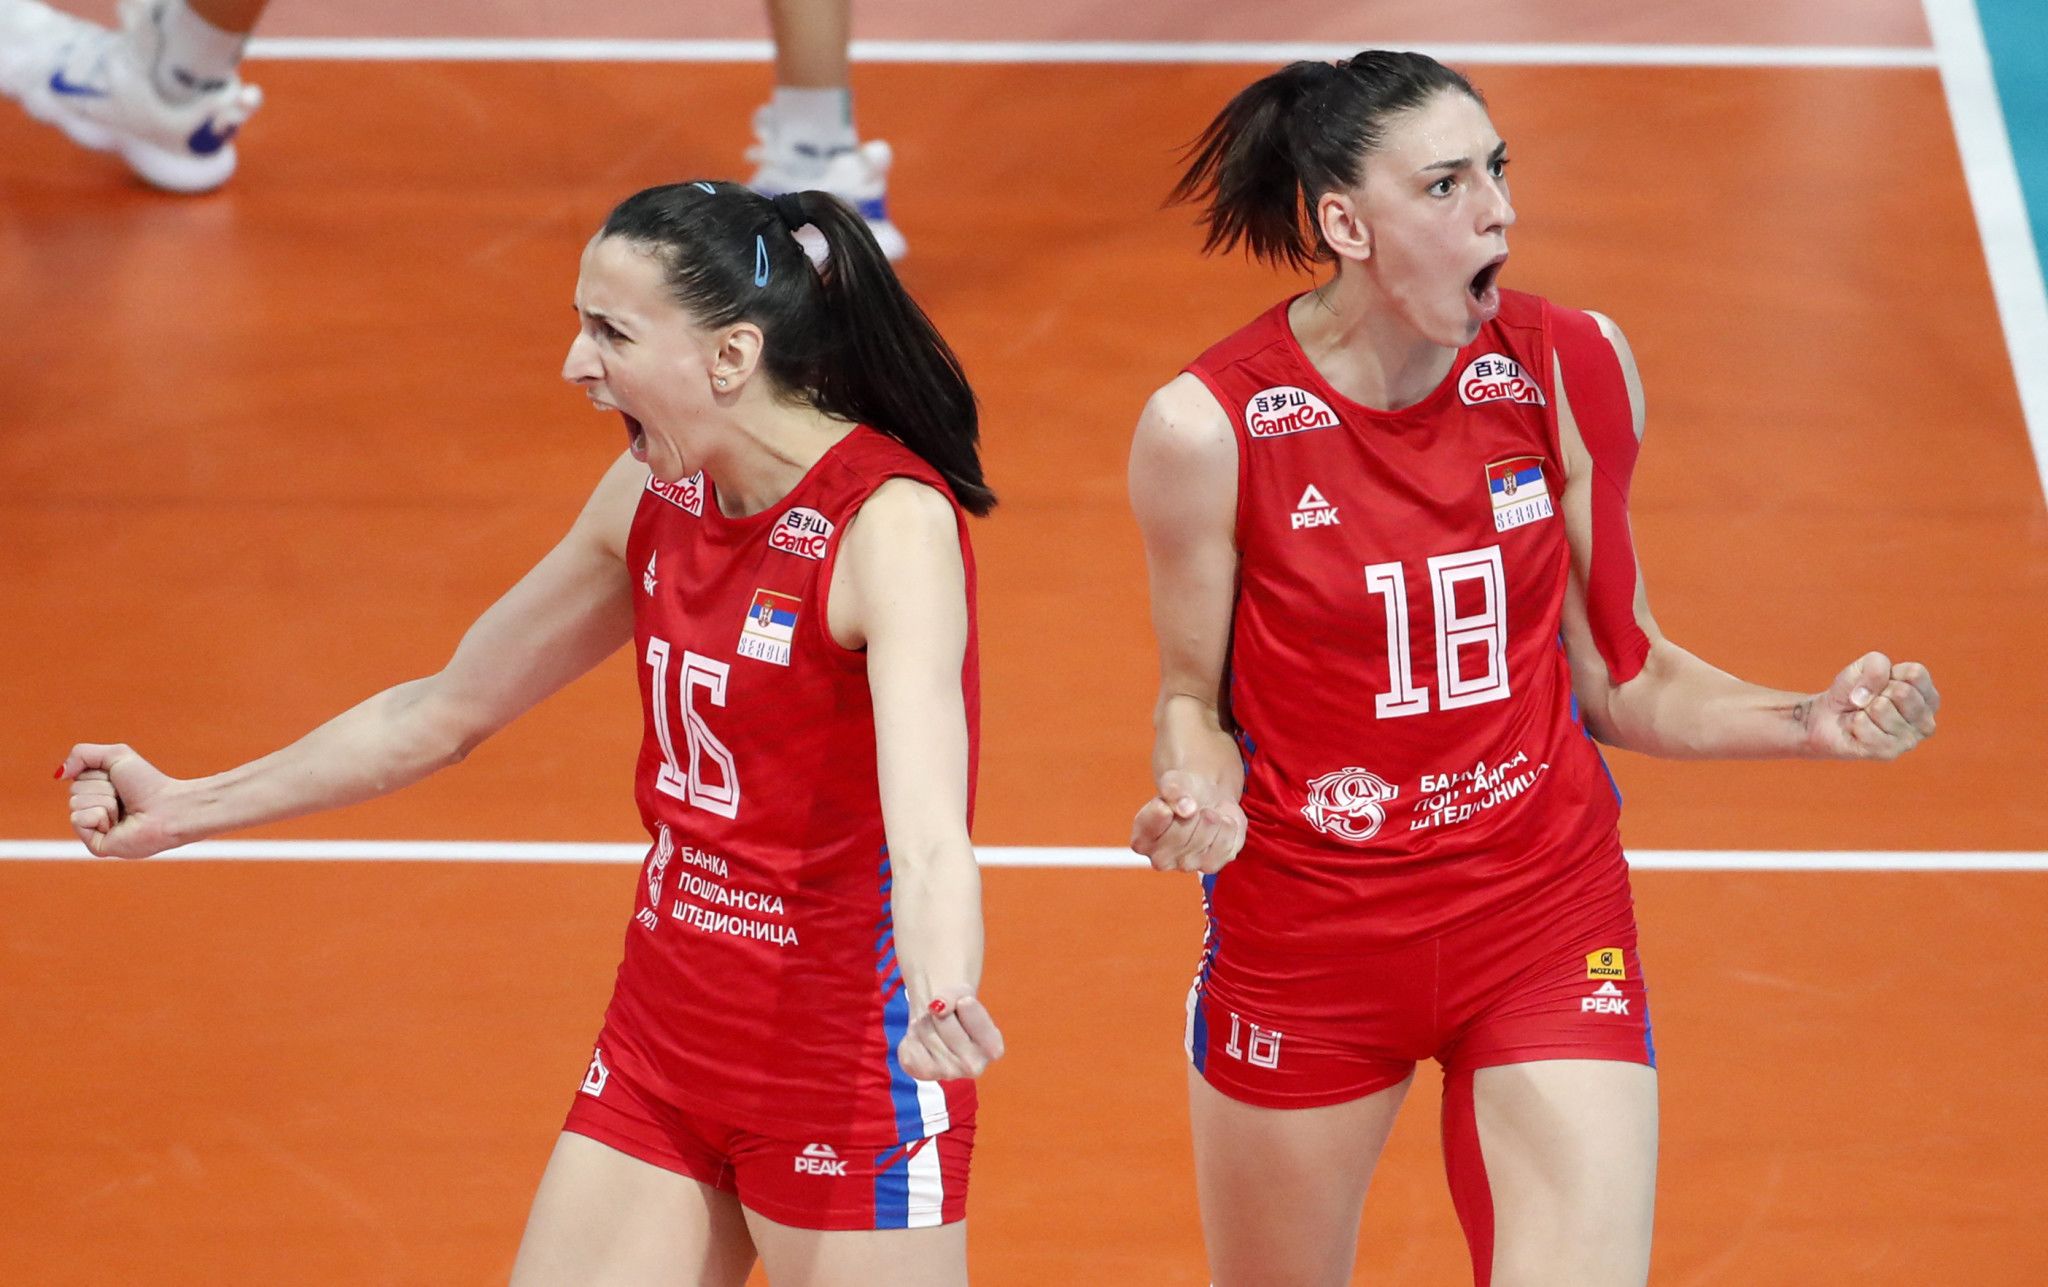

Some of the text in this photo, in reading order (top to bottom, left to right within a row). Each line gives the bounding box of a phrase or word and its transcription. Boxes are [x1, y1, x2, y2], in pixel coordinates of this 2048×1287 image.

[1473, 360, 1519, 378] 百岁山
[1255, 391, 1307, 413] 百岁山
[1290, 507, 1341, 530] PEAK
[1496, 497, 1553, 530] SERBIA
[772, 523, 828, 557] Gante
[1364, 544, 1511, 720] 18
[739, 636, 790, 665] SERBIA
[646, 635, 741, 820] 16
[681, 846, 729, 879] БАНКА
[677, 872, 785, 915] ПОШТАНСКА
[635, 906, 659, 932] 1921
[671, 899, 799, 947] ШТЕДИОНИЦА
[1590, 967, 1623, 976] MOZZART
[1581, 997, 1631, 1016] PEAK
[794, 1155, 847, 1177] PEAK
